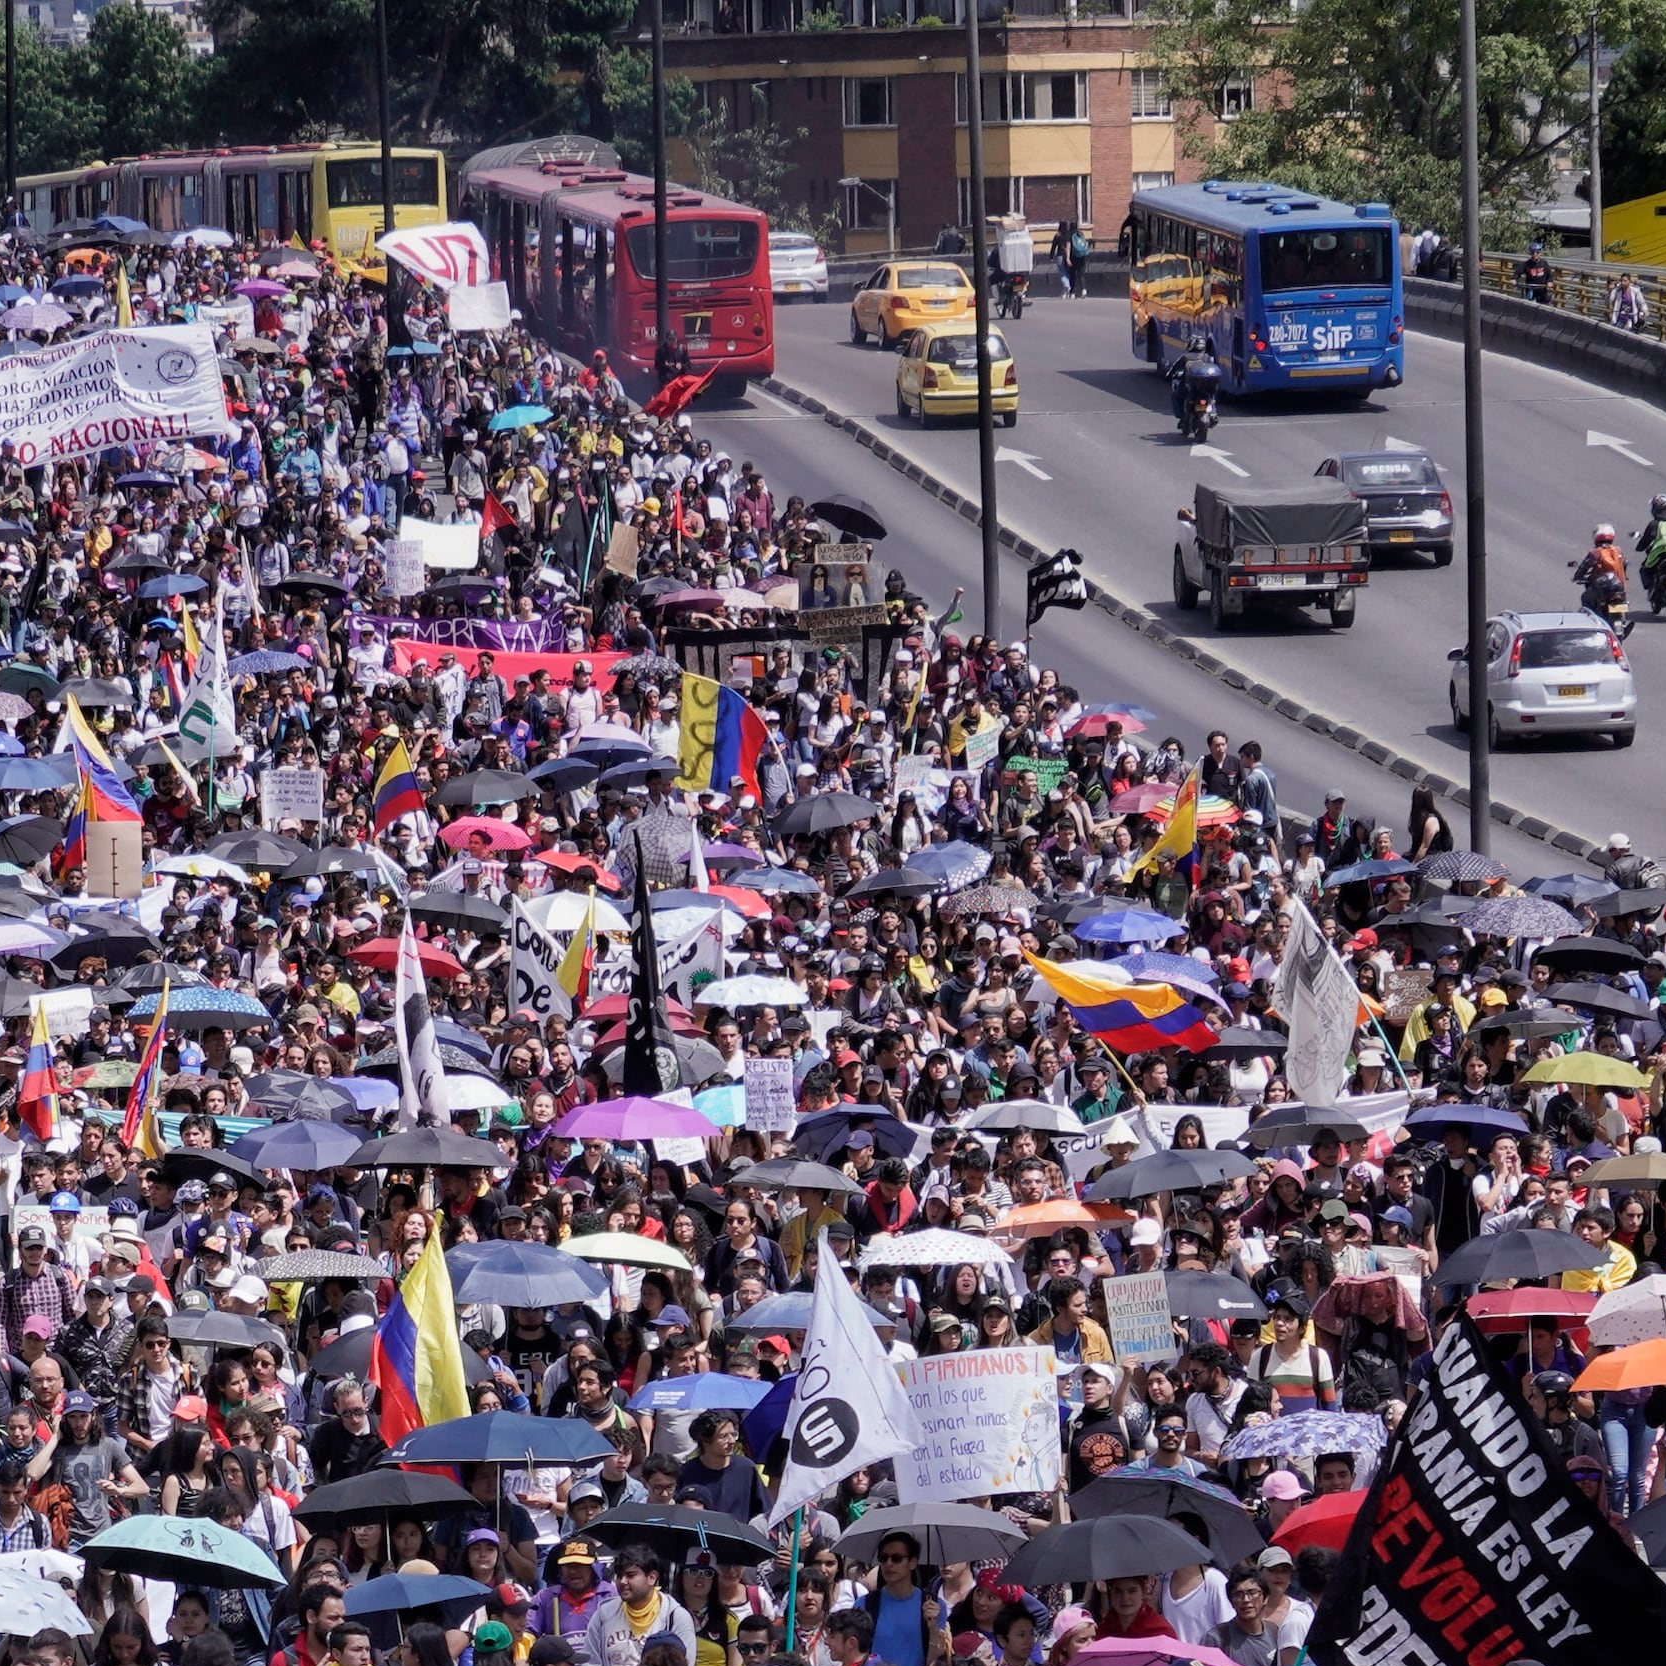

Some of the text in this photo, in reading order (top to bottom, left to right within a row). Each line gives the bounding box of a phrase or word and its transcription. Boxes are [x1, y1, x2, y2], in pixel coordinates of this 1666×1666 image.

[29, 378, 119, 409] PODREMOS
[63, 391, 166, 420] NEOLIBERAL
[50, 413, 192, 459] NACIONAL!
[1362, 464, 1411, 475] PRENSA
[492, 610, 565, 653] VIVAS
[745, 1061, 790, 1074] RESISTO
[937, 1388, 959, 1406] los
[962, 1385, 987, 1414] que
[976, 1412, 1008, 1428] niños
[934, 1442, 944, 1458] la
[1433, 1321, 1595, 1571] CUANDO LA
[917, 1464, 982, 1488] del estado
[1477, 1520, 1593, 1649] ES LEY
